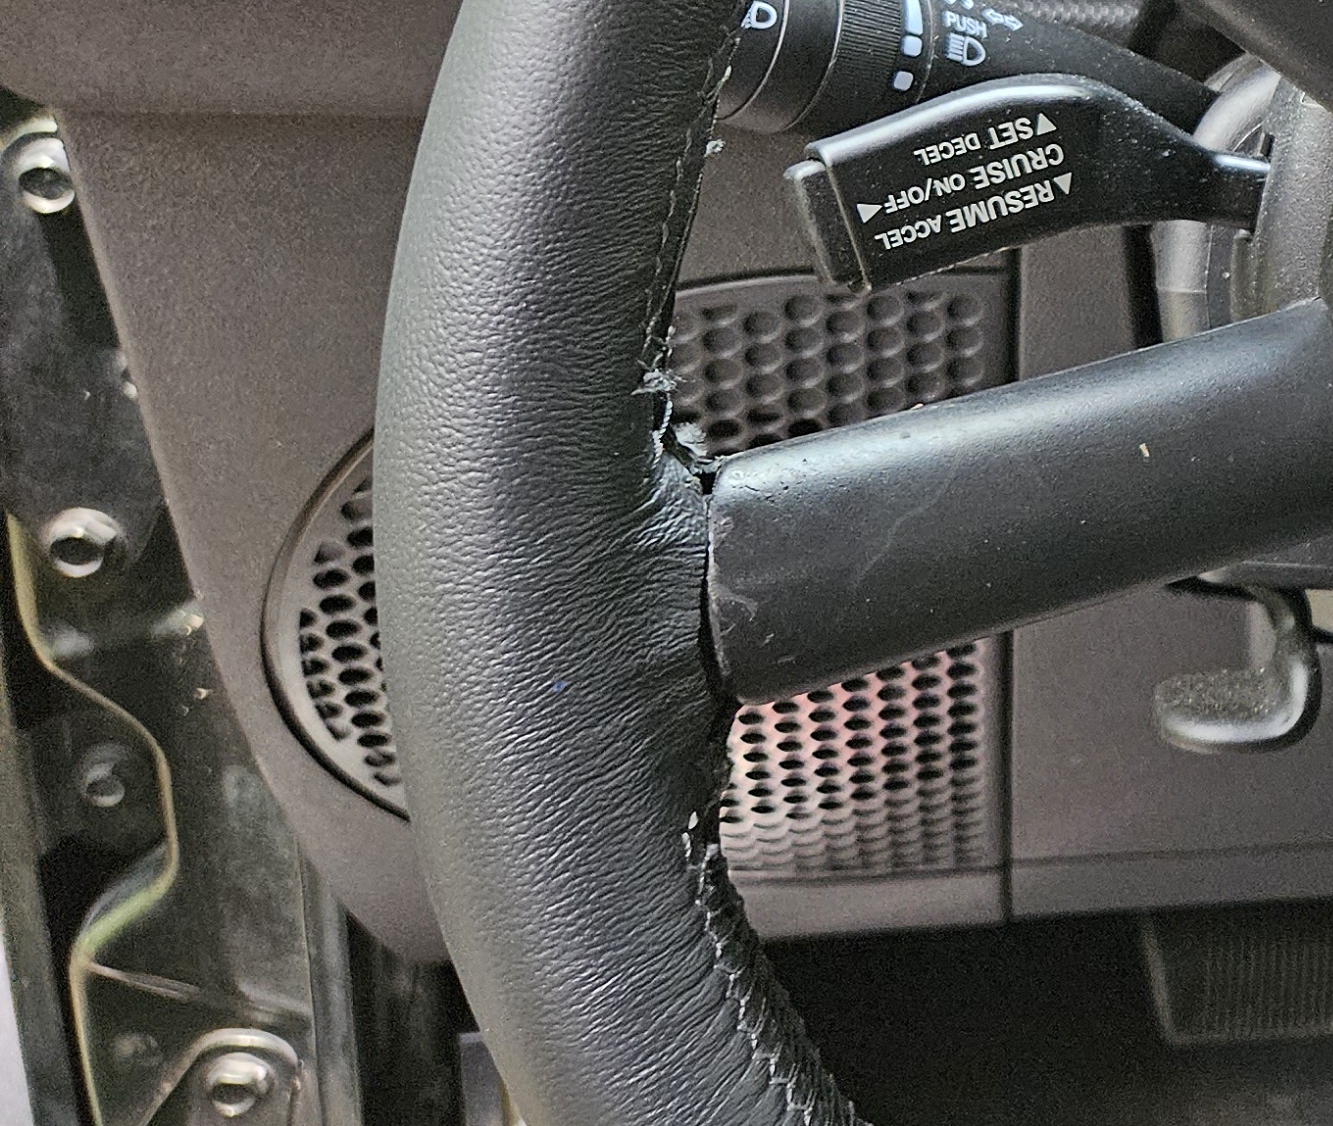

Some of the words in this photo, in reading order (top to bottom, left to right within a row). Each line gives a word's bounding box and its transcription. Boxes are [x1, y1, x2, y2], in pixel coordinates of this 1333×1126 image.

[945, 10, 987, 38] PUSH
[913, 133, 981, 165] DECEL
[989, 118, 1033, 149] SET
[969, 143, 1065, 190] CRUISE
[884, 173, 965, 214] ON/OFF
[950, 180, 1054, 232] RESUME
[875, 215, 941, 249] ACCEL
